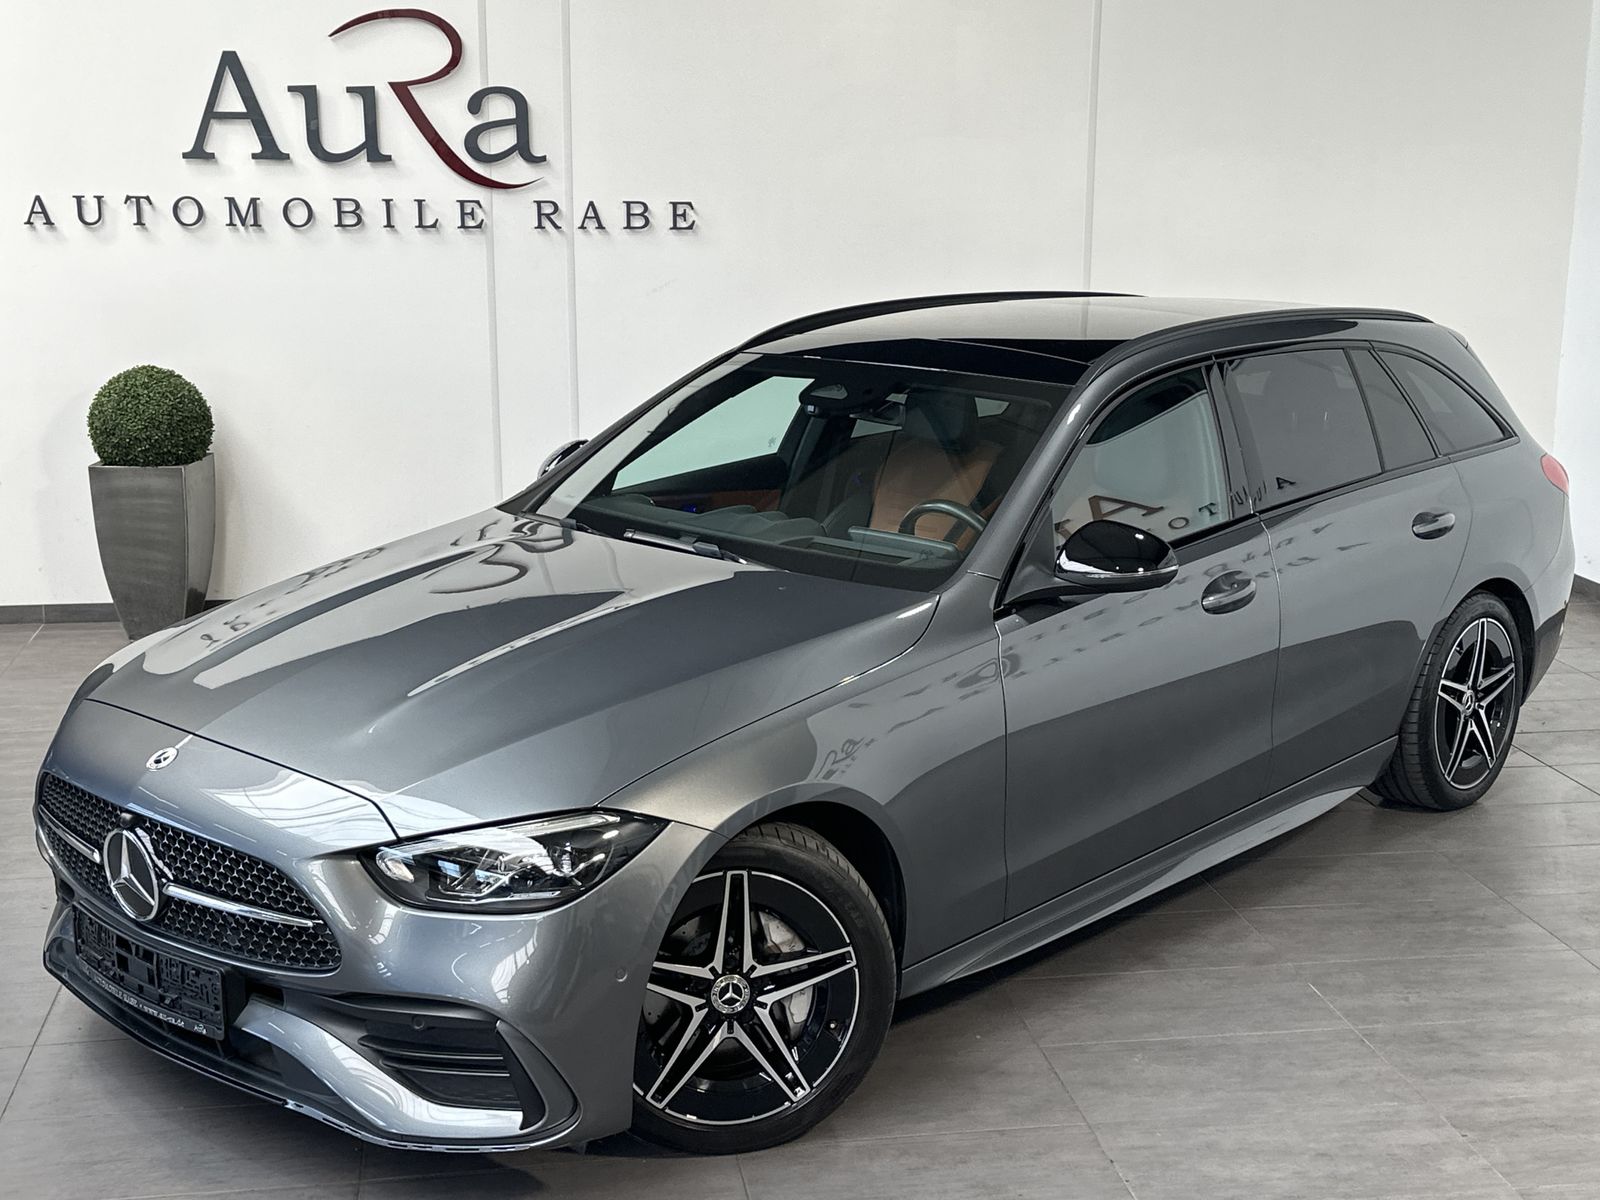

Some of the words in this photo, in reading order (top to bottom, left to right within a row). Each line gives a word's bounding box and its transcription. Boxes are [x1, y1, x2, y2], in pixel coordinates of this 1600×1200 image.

[182, 8, 547, 190] AuRa
[23, 194, 485, 230] AUTOMOBILE
[533, 200, 696, 231] RABE
